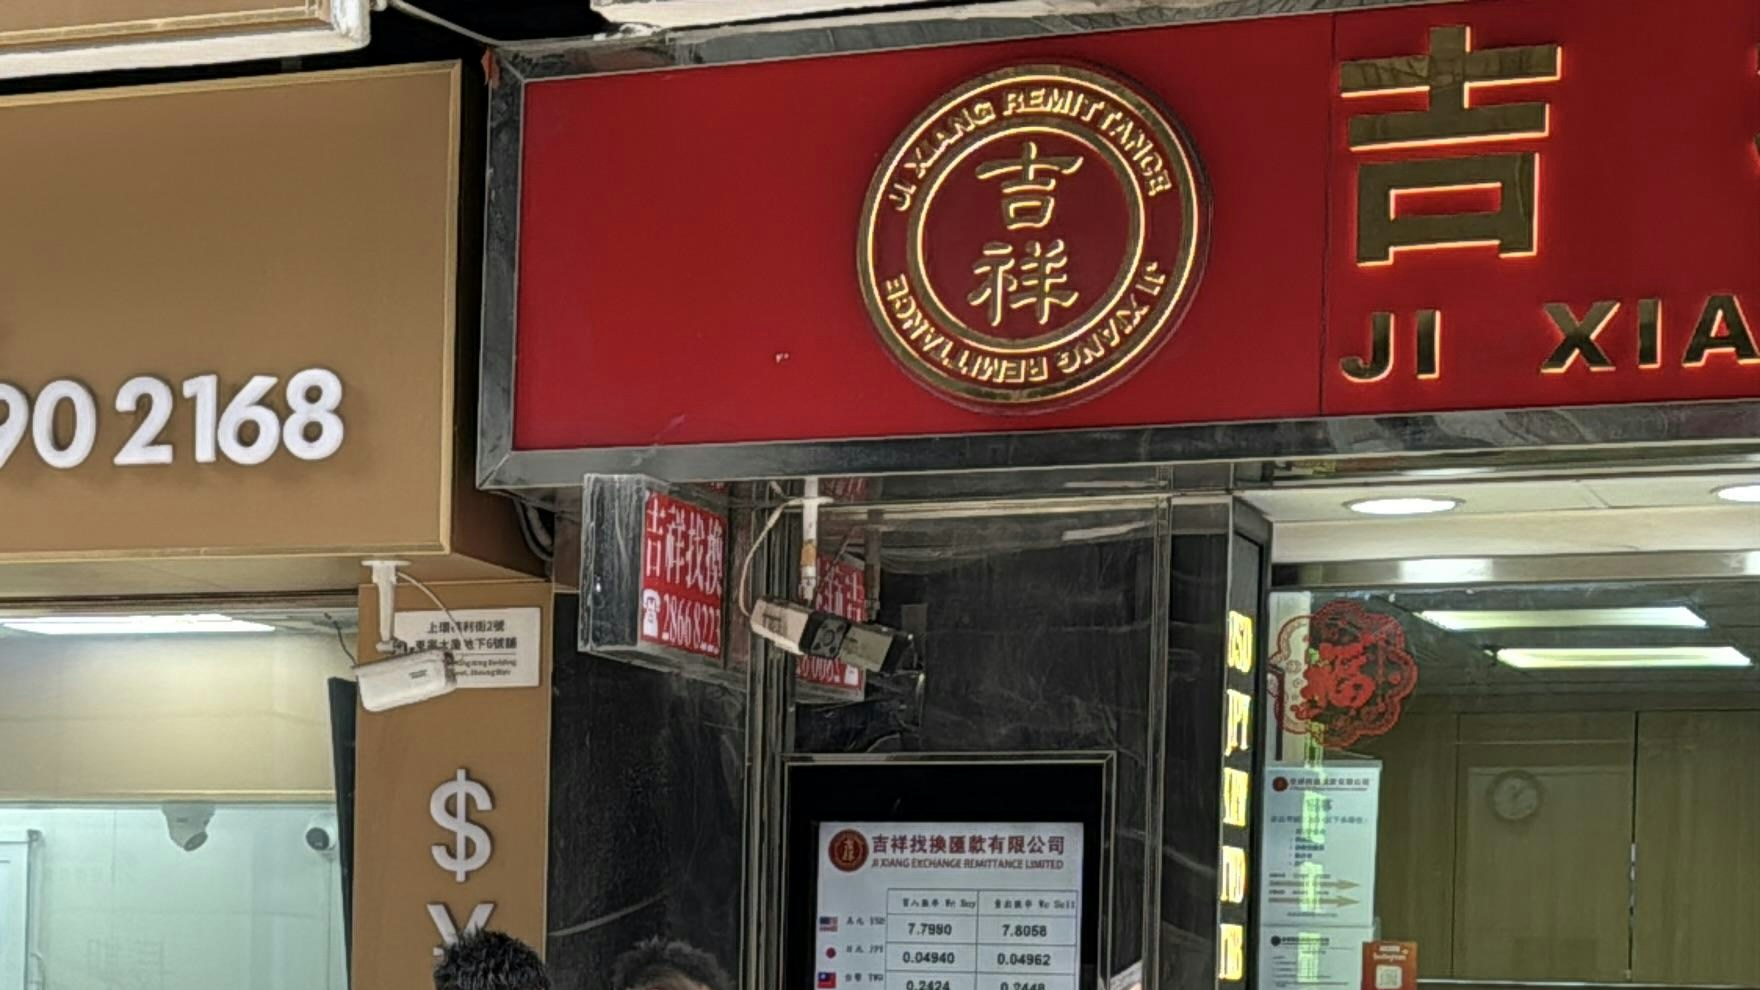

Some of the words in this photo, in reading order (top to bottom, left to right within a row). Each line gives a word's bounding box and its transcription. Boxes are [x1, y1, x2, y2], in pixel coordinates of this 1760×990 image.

[889, 183, 917, 212] JI
[904, 101, 996, 179] XIANG
[1002, 88, 1172, 196] REMITTANCE
[1338, 25, 1562, 267] 吉
[968, 142, 1084, 327] 吉祥
[885, 273, 1049, 384] REMITTANCE
[1340, 309, 1443, 383] JI
[113, 367, 344, 467] 2168
[430, 769, 493, 882] $
